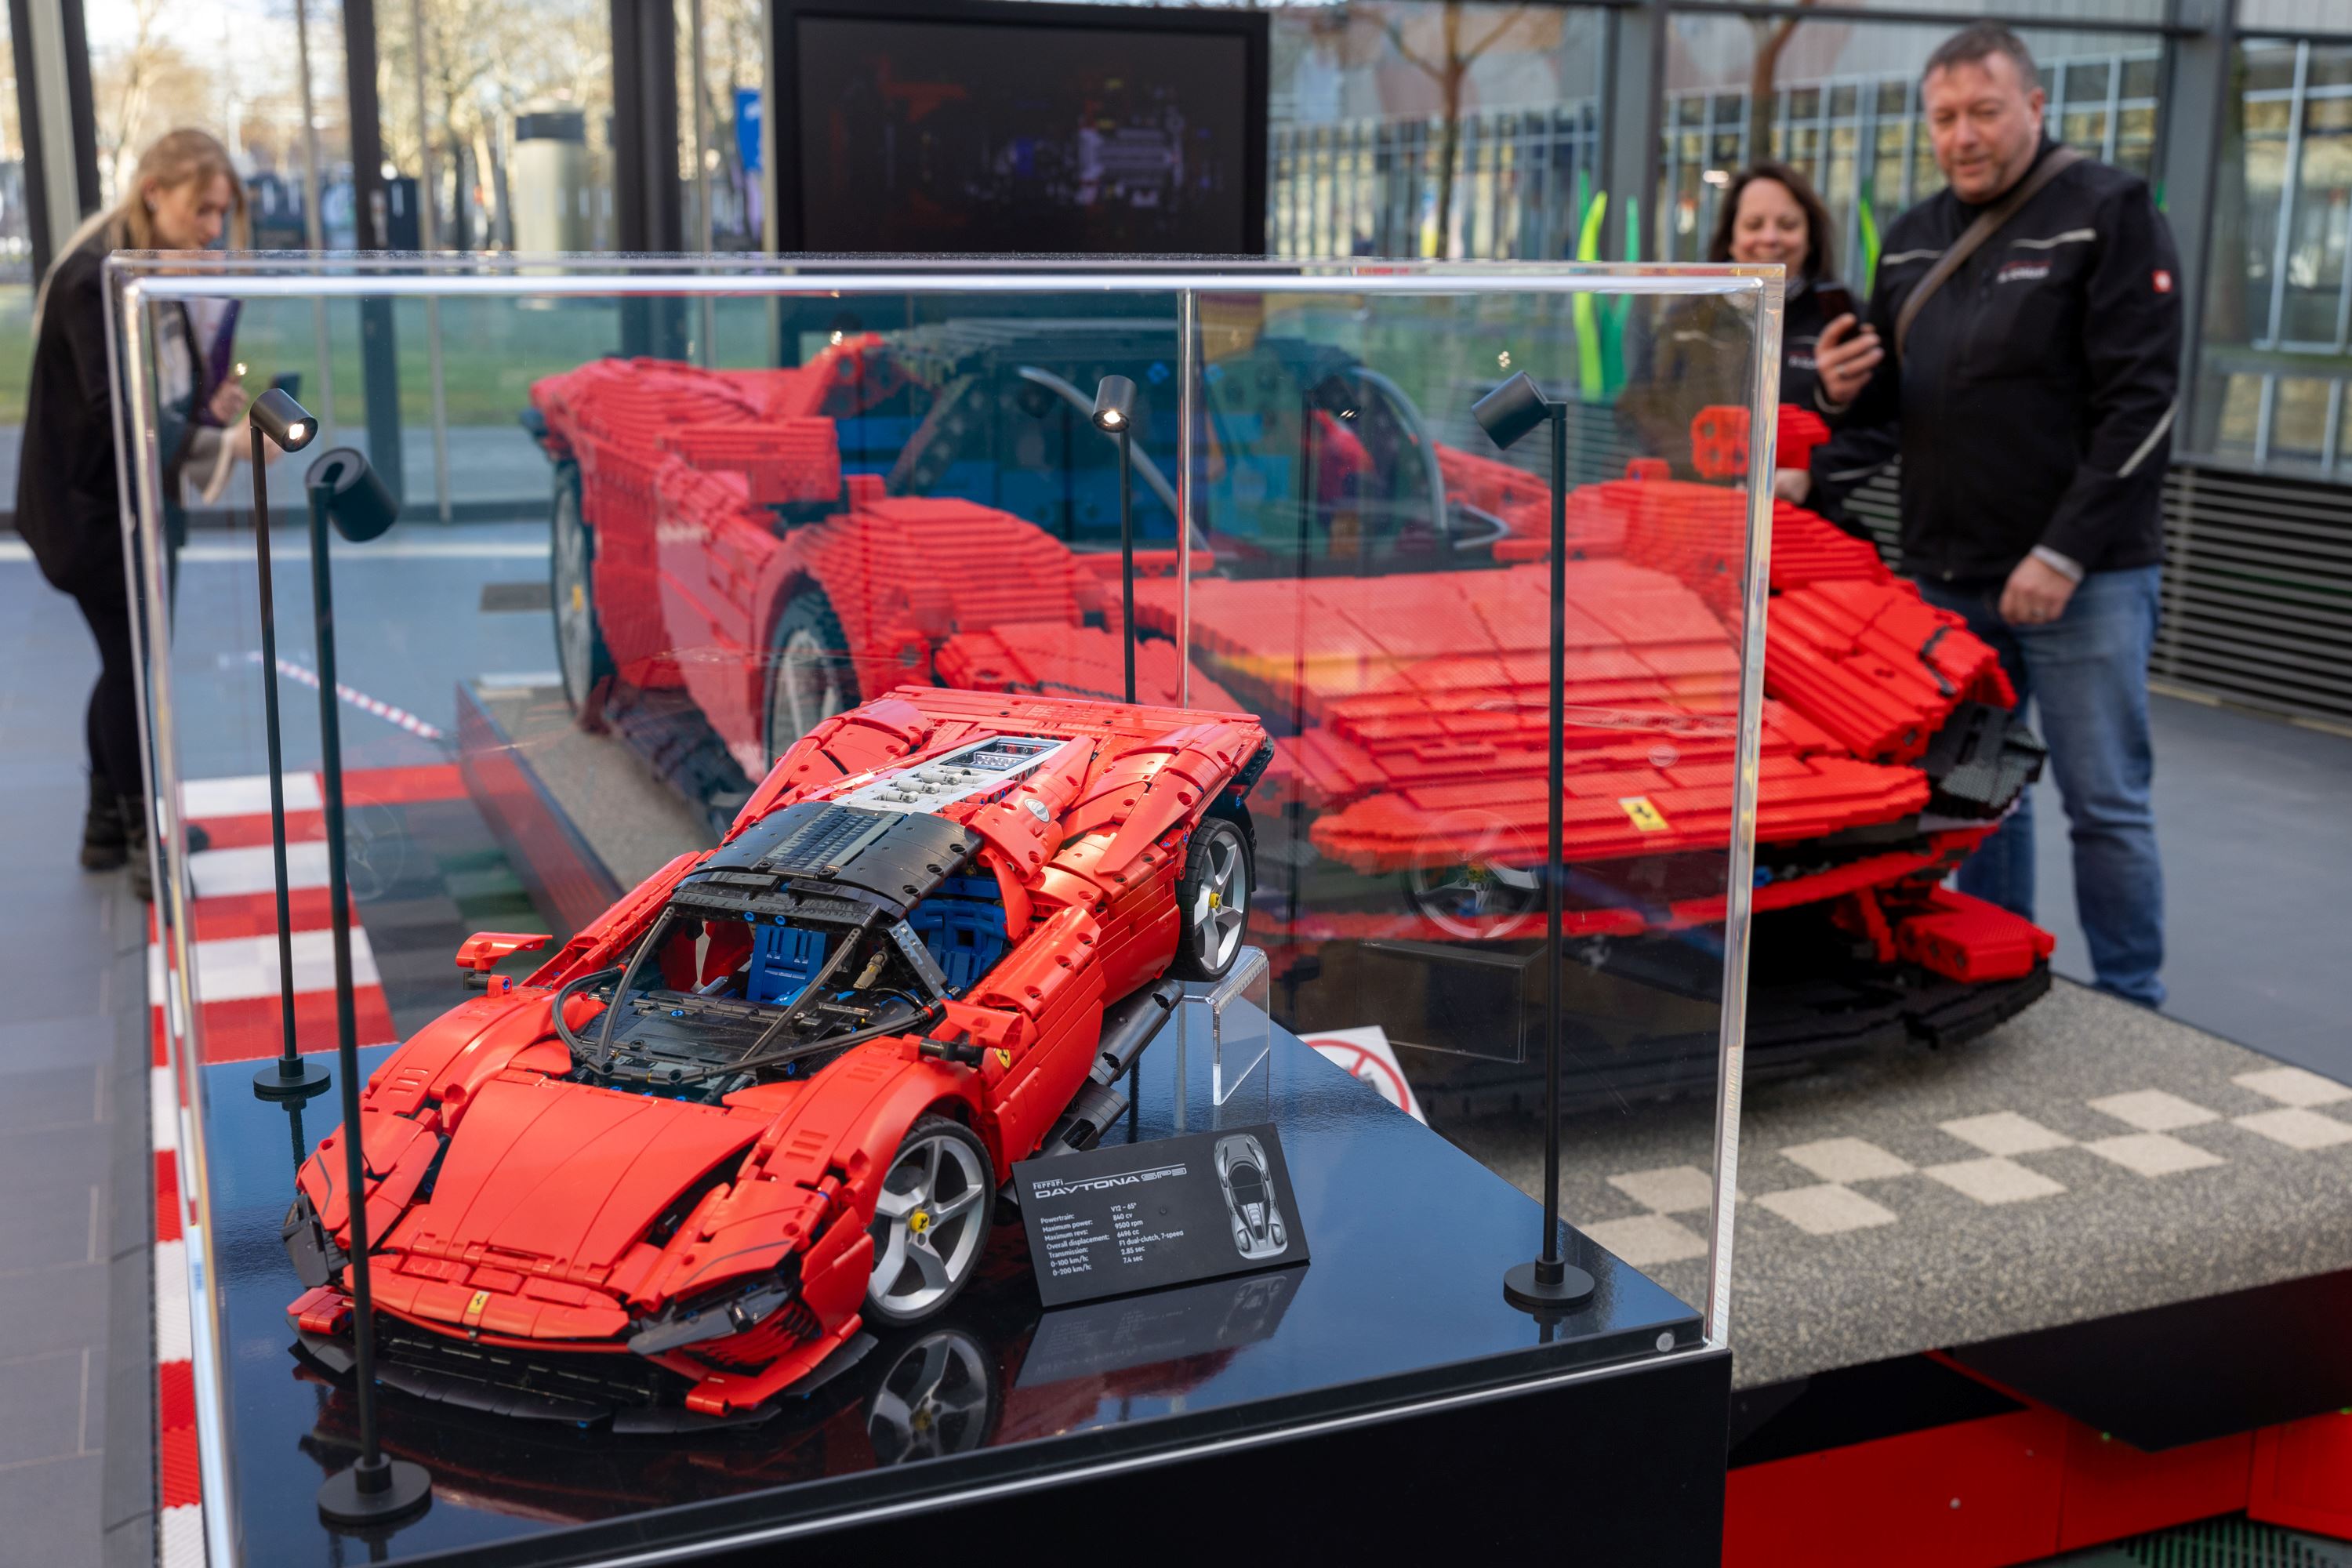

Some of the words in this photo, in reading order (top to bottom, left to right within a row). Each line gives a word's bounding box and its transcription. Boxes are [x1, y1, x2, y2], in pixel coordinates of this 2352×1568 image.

[1035, 1175, 1140, 1199] DAYTONA
[1141, 1167, 1187, 1181] SP3
[1040, 1214, 1075, 1225] Powertrain:
[1042, 1223, 1071, 1232] Maximum
[1072, 1220, 1093, 1229] power:
[1044, 1232, 1073, 1242] Maximum
[1073, 1229, 1088, 1237] revs:
[1114, 1221, 1130, 1229] 9500
[1047, 1241, 1068, 1250] Overall
[1069, 1235, 1109, 1247] displacement:
[1048, 1247, 1089, 1259] Transmission:
[1127, 1234, 1161, 1245] dual-clutch,
[1161, 1230, 1184, 1240] 7-speed
[1050, 1258, 1069, 1268] 0-100
[1069, 1255, 1089, 1265] km/h:
[1121, 1247, 1134, 1255] 2.85
[1052, 1266, 1072, 1276] 0-200
[1072, 1264, 1092, 1273] km/h:
